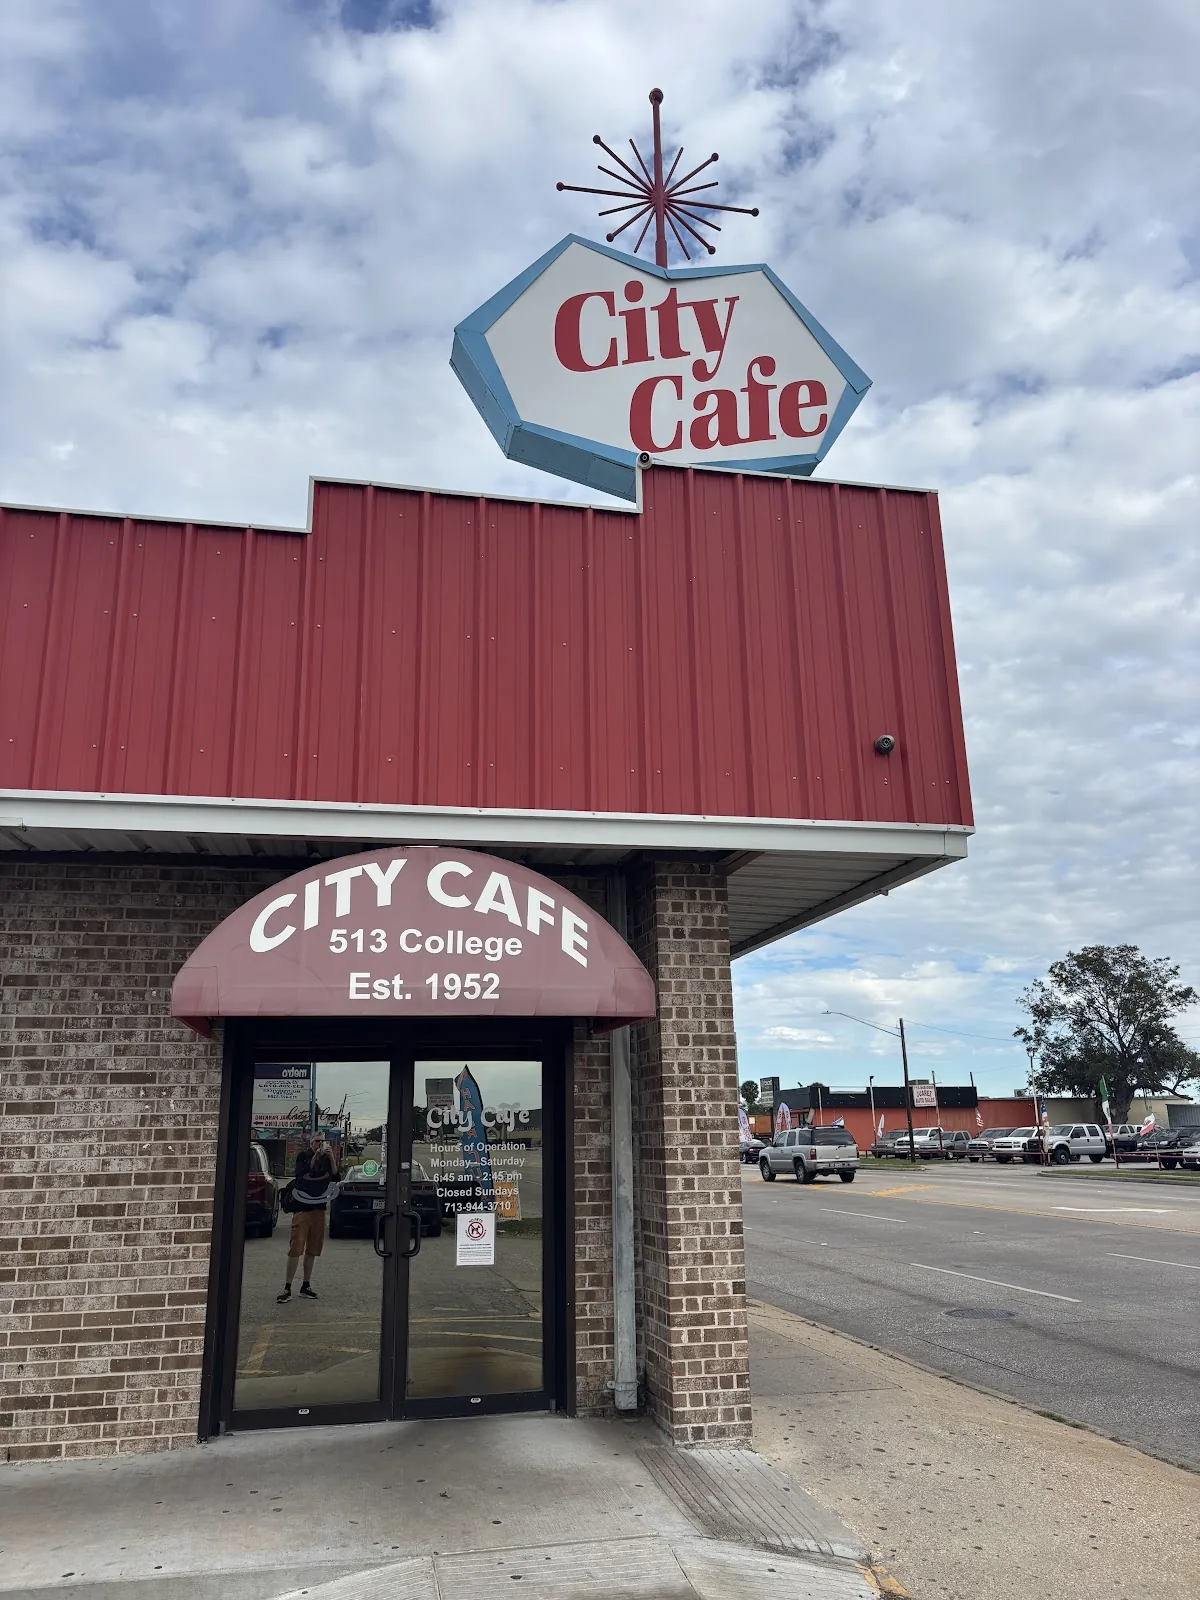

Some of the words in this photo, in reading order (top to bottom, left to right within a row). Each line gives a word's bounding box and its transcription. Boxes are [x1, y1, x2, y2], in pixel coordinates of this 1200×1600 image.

[554, 280, 739, 382] City
[629, 355, 828, 453] Cafe
[249, 858, 408, 953] CITY
[426, 860, 588, 969] CAFE
[329, 928, 388, 953] 513
[399, 928, 523, 961] College
[349, 972, 412, 1000] Est.
[425, 972, 500, 1000] 1952
[427, 1105, 473, 1132] City
[481, 1103, 530, 1132] Cafe
[430, 1143, 460, 1152] Hours
[464, 1143, 474, 1152] of
[476, 1142, 526, 1153] Operation
[431, 1158, 471, 1168] Monday
[480, 1157, 525, 1168] Saturday
[433, 1173, 455, 1182] 6:45
[458, 1174, 473, 1182] am
[483, 1171, 504, 1181] 2:45
[507, 1172, 522, 1182] pm
[436, 1187, 472, 1197] Closed
[475, 1187, 519, 1198] Sundays
[444, 1201, 511, 1212] 713-944-3710
